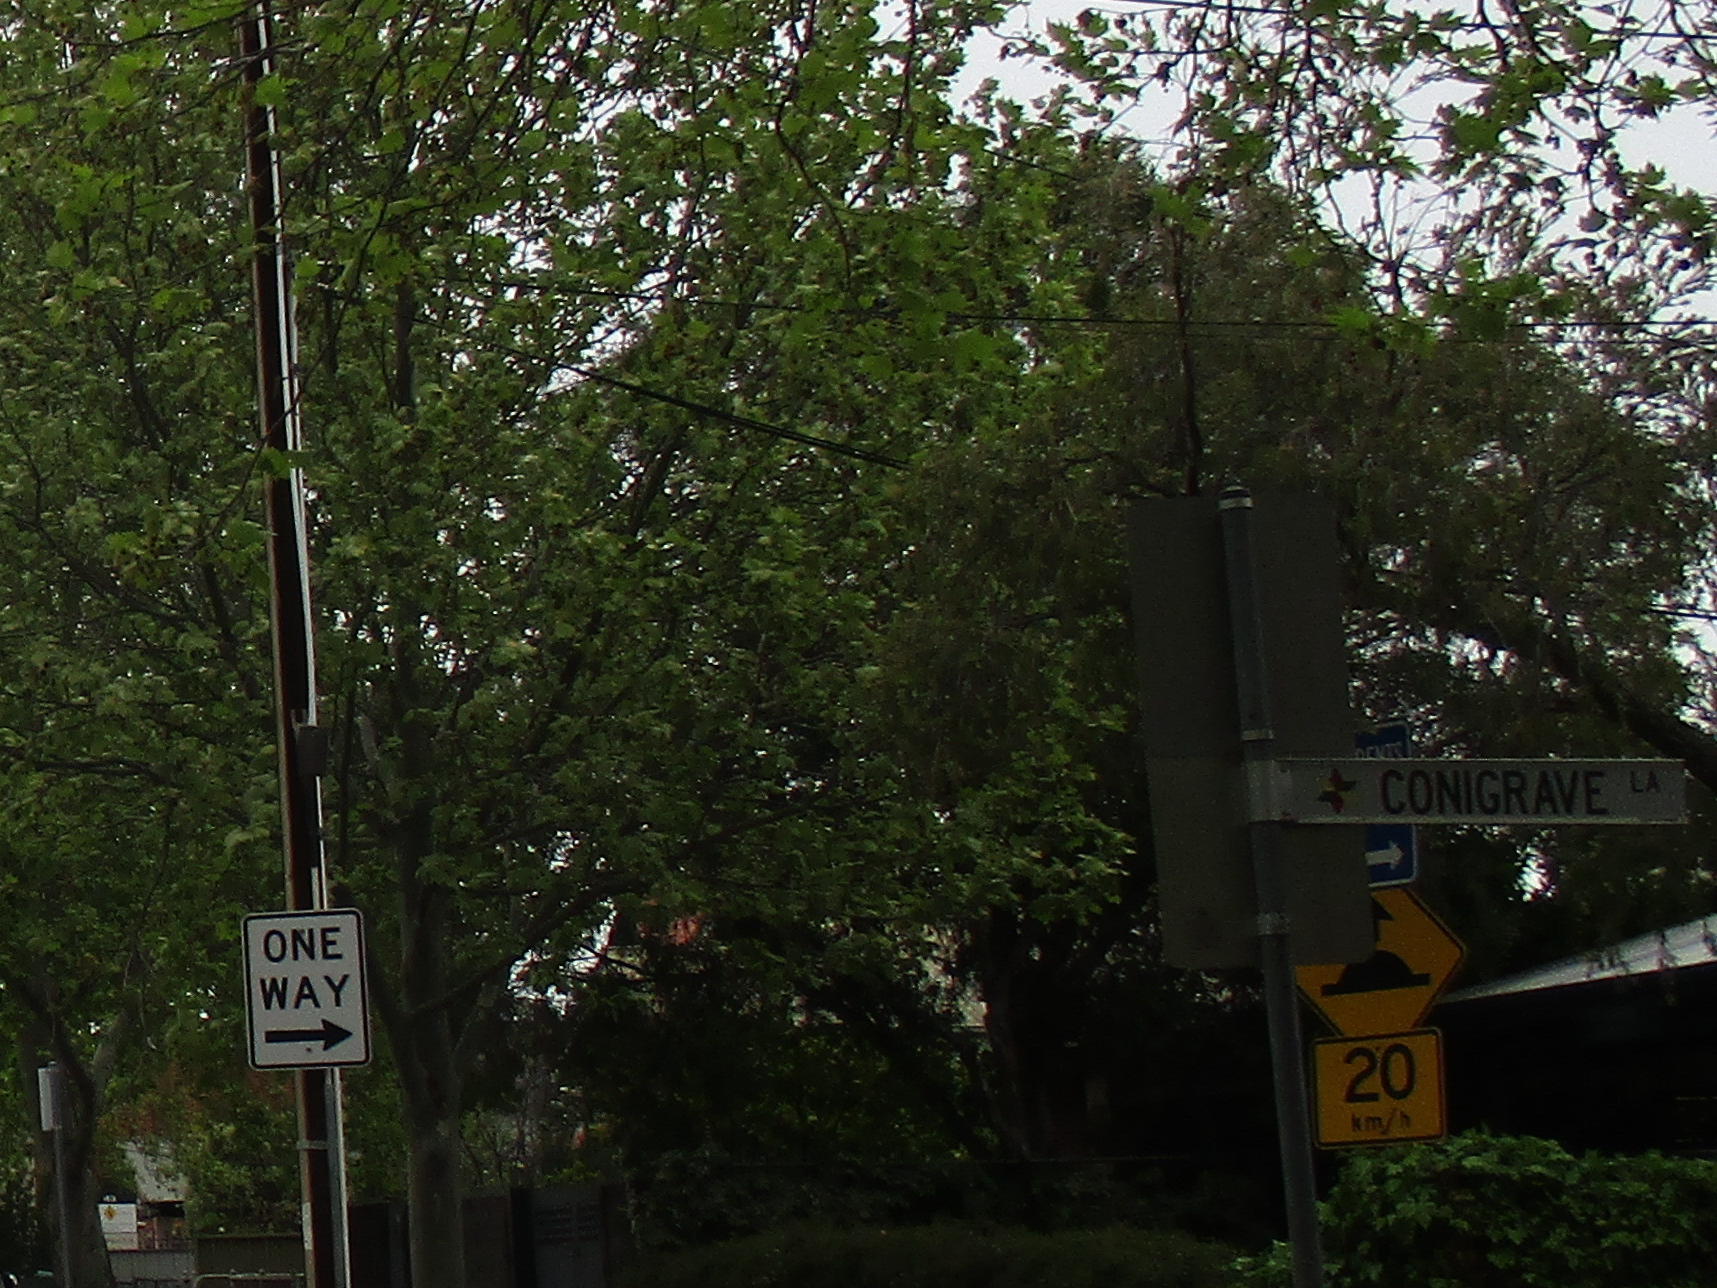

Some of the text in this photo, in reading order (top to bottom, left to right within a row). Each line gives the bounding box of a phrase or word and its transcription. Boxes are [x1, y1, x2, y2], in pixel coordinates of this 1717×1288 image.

[1380, 768, 1662, 817] CONIGRAVE LA
[263, 926, 344, 963] ONE
[259, 973, 351, 1011] WAY
[1343, 1042, 1417, 1105] 20
[1351, 1108, 1412, 1136] km/h
